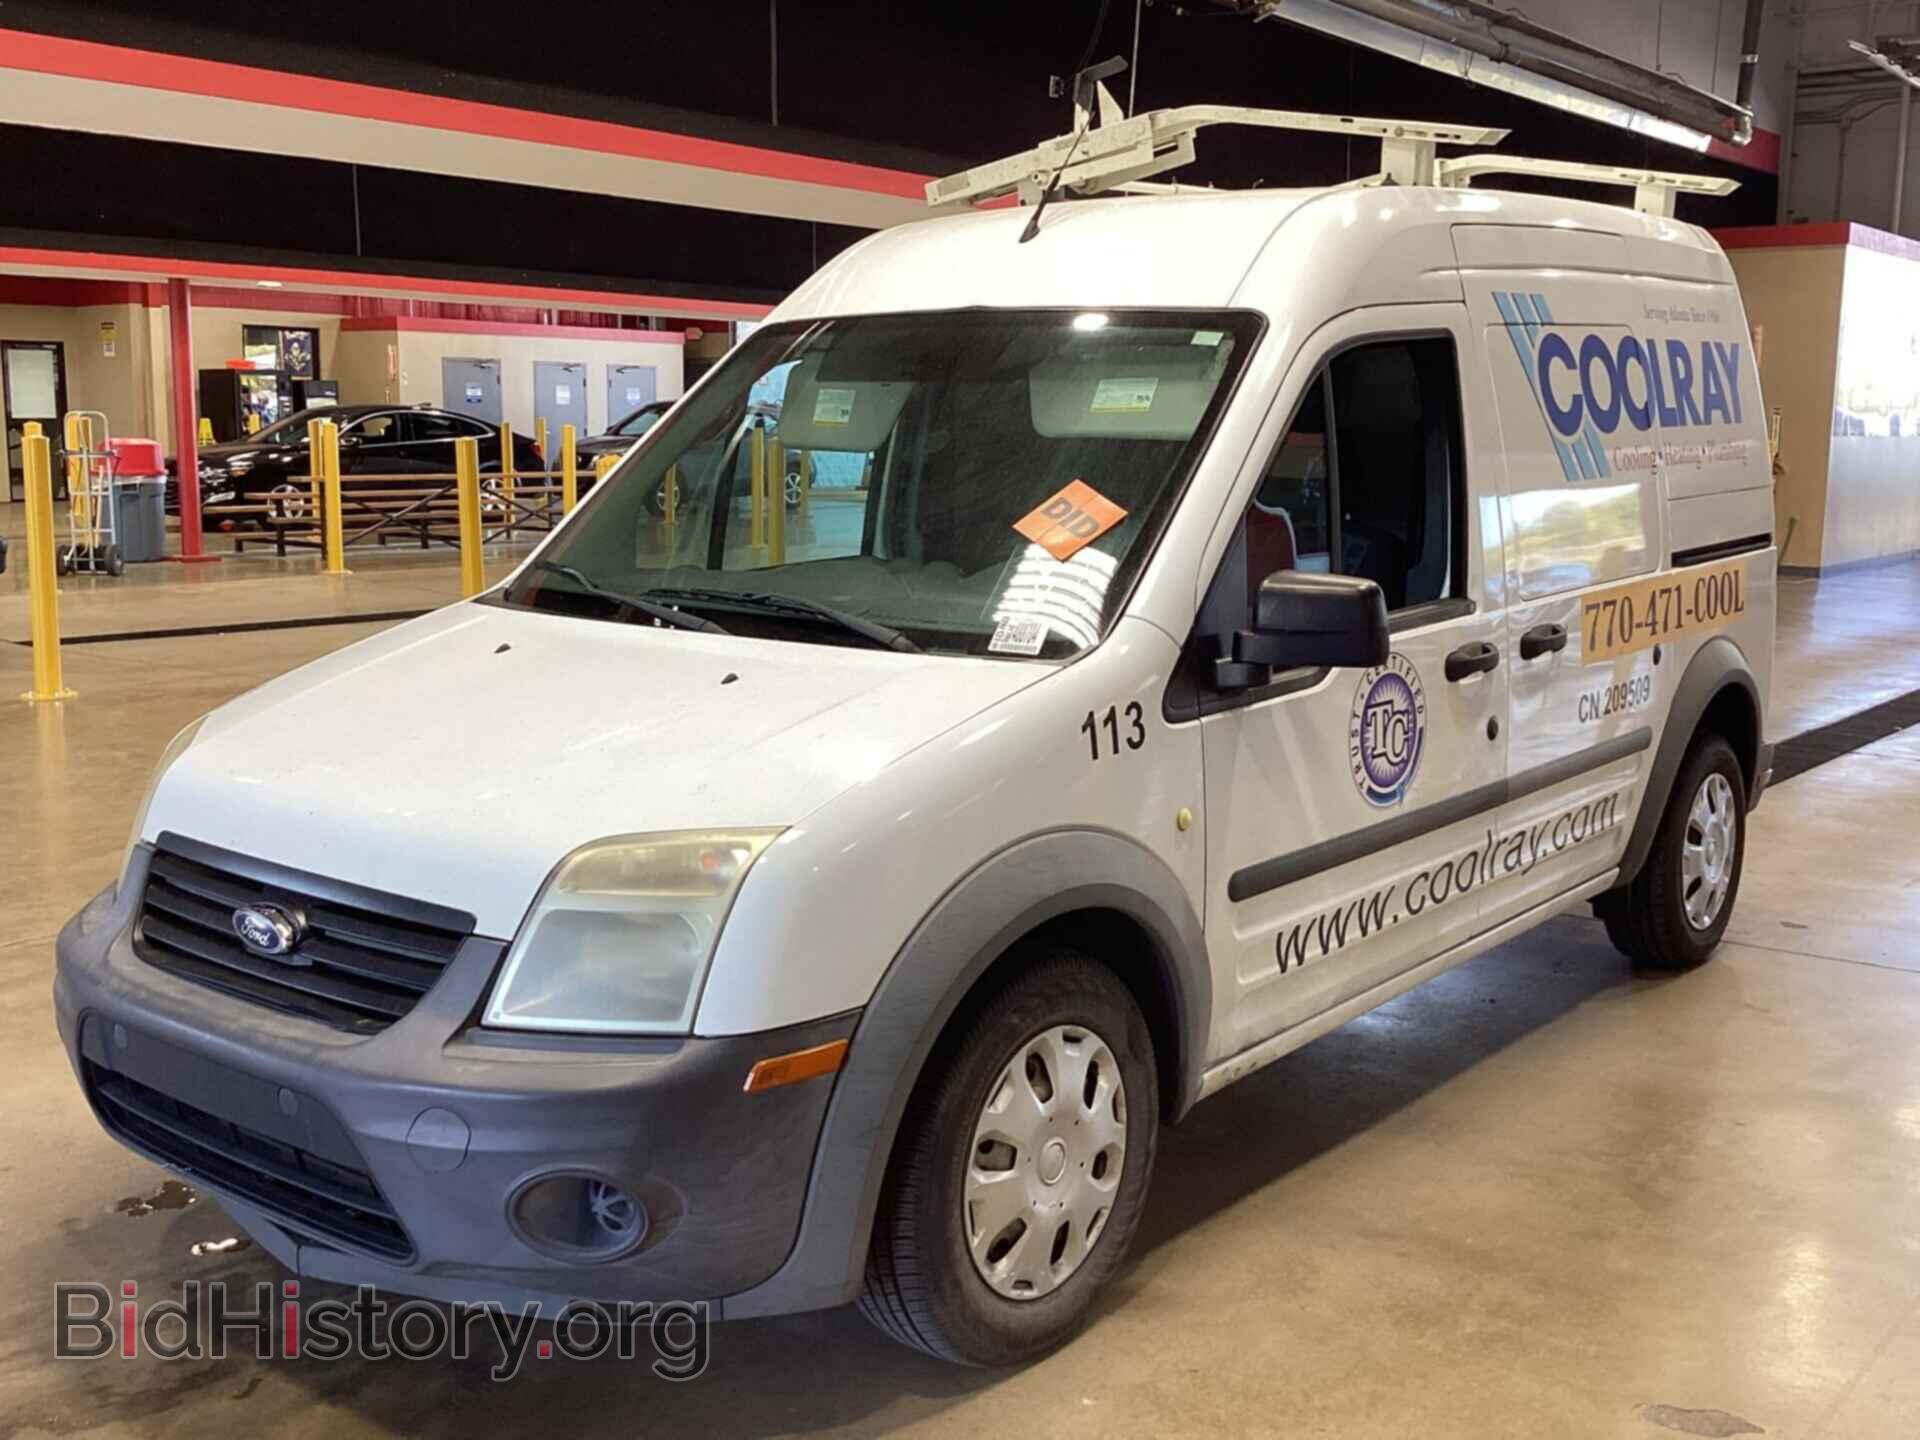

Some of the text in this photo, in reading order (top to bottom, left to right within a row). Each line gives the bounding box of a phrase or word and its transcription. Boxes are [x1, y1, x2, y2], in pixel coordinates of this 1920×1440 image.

[1538, 332, 1742, 436] COOLRAY
[1585, 569, 1744, 652] 770-471-COOL
[1081, 701, 1146, 760] 113
[1366, 699, 1410, 767] TC
[1578, 675, 1650, 723] CN 209509
[1350, 712, 1366, 790] TRUST
[1275, 792, 1620, 974] www.coolray.com
[240, 917, 272, 947] Ford
